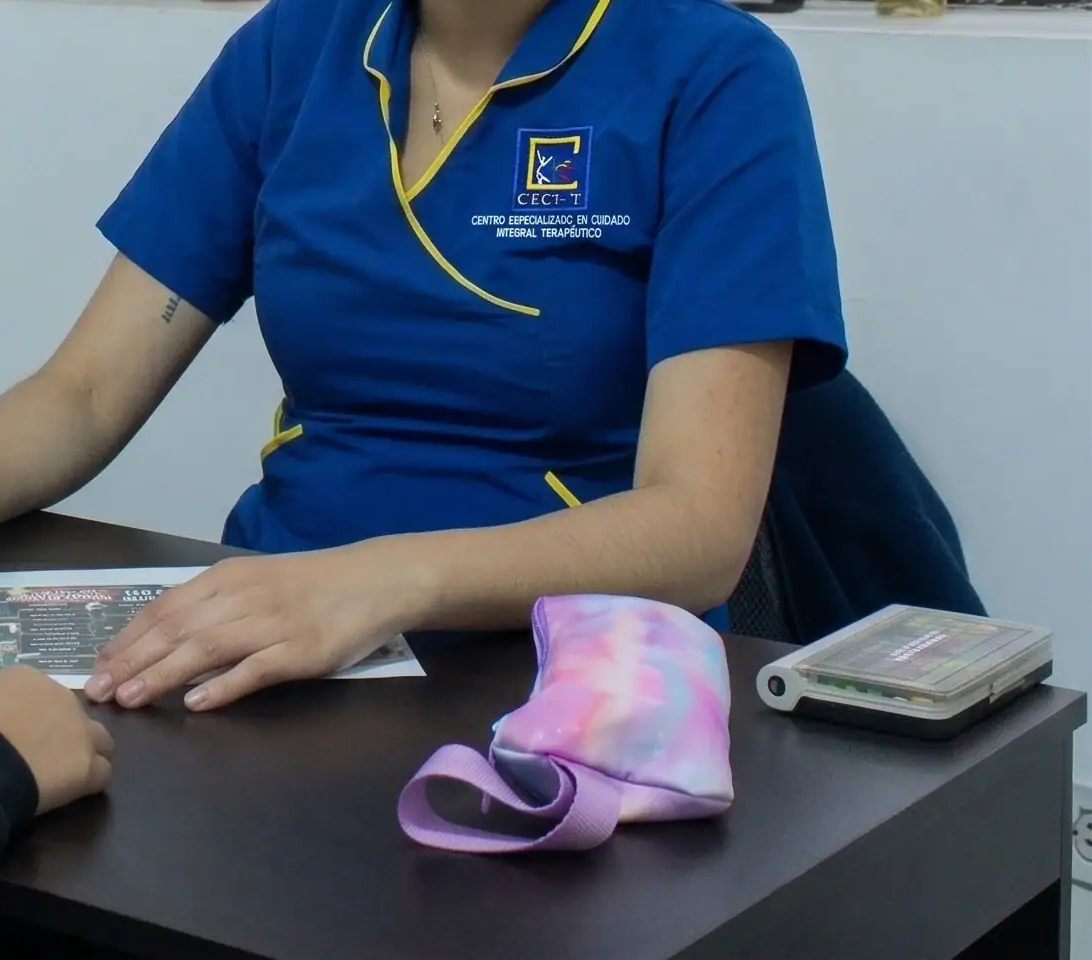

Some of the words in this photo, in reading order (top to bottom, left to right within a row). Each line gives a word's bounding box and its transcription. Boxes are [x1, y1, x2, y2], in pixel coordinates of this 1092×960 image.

[471, 215, 506, 226] CENTRO
[576, 215, 588, 225] EN
[590, 215, 631, 226] CUIDADO
[540, 225, 602, 238] TERAPÉUTICO
